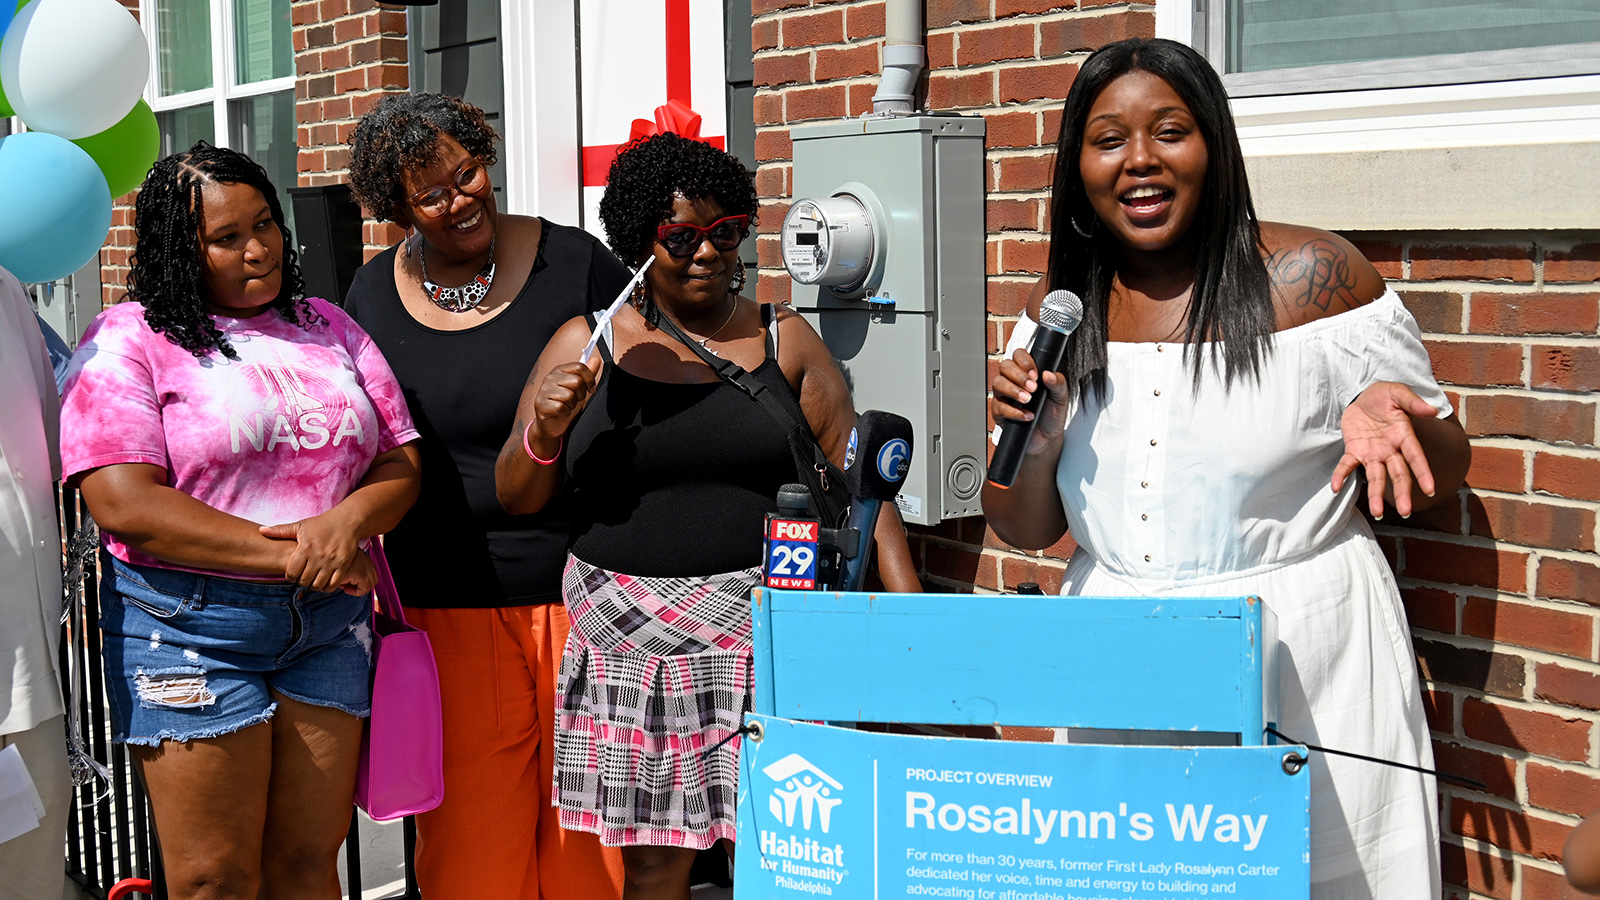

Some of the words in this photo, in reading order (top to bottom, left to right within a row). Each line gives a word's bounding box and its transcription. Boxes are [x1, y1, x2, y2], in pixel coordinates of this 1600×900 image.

[229, 407, 365, 453] NASA
[776, 522, 813, 540] FOX
[771, 545, 814, 576] 29
[770, 579, 812, 588] NEWS
[907, 768, 973, 783] PROJECT
[976, 772, 1053, 787] OVERVIEW
[906, 792, 1154, 844] Rosalynn's
[1165, 804, 1268, 851] Way
[761, 830, 844, 867] Habitat
[761, 857, 778, 871] for
[907, 849, 927, 860] For
[932, 853, 963, 863] more
[967, 853, 994, 864] than
[998, 855, 1015, 866] 30
[1019, 859, 1056, 870] years,
[1061, 859, 1103, 871] former
[1108, 860, 1135, 872] First
[1140, 862, 1171, 876] Lady
[1175, 863, 1234, 877] Rosalynn
[1238, 864, 1279, 875] Carter
[775, 875, 832, 895] Philadelphia
[907, 866, 968, 880] dedicated
[972, 871, 992, 881] her
[996, 873, 1031, 886] voice,
[1036, 875, 1062, 886] time
[1066, 878, 1089, 888] and
[1094, 880, 1138, 892] energy
[1142, 881, 1154, 890] to
[1159, 880, 1207, 894] building
[1212, 882, 1235, 893] and
[907, 884, 974, 900] advocating
[979, 888, 995, 899] for
